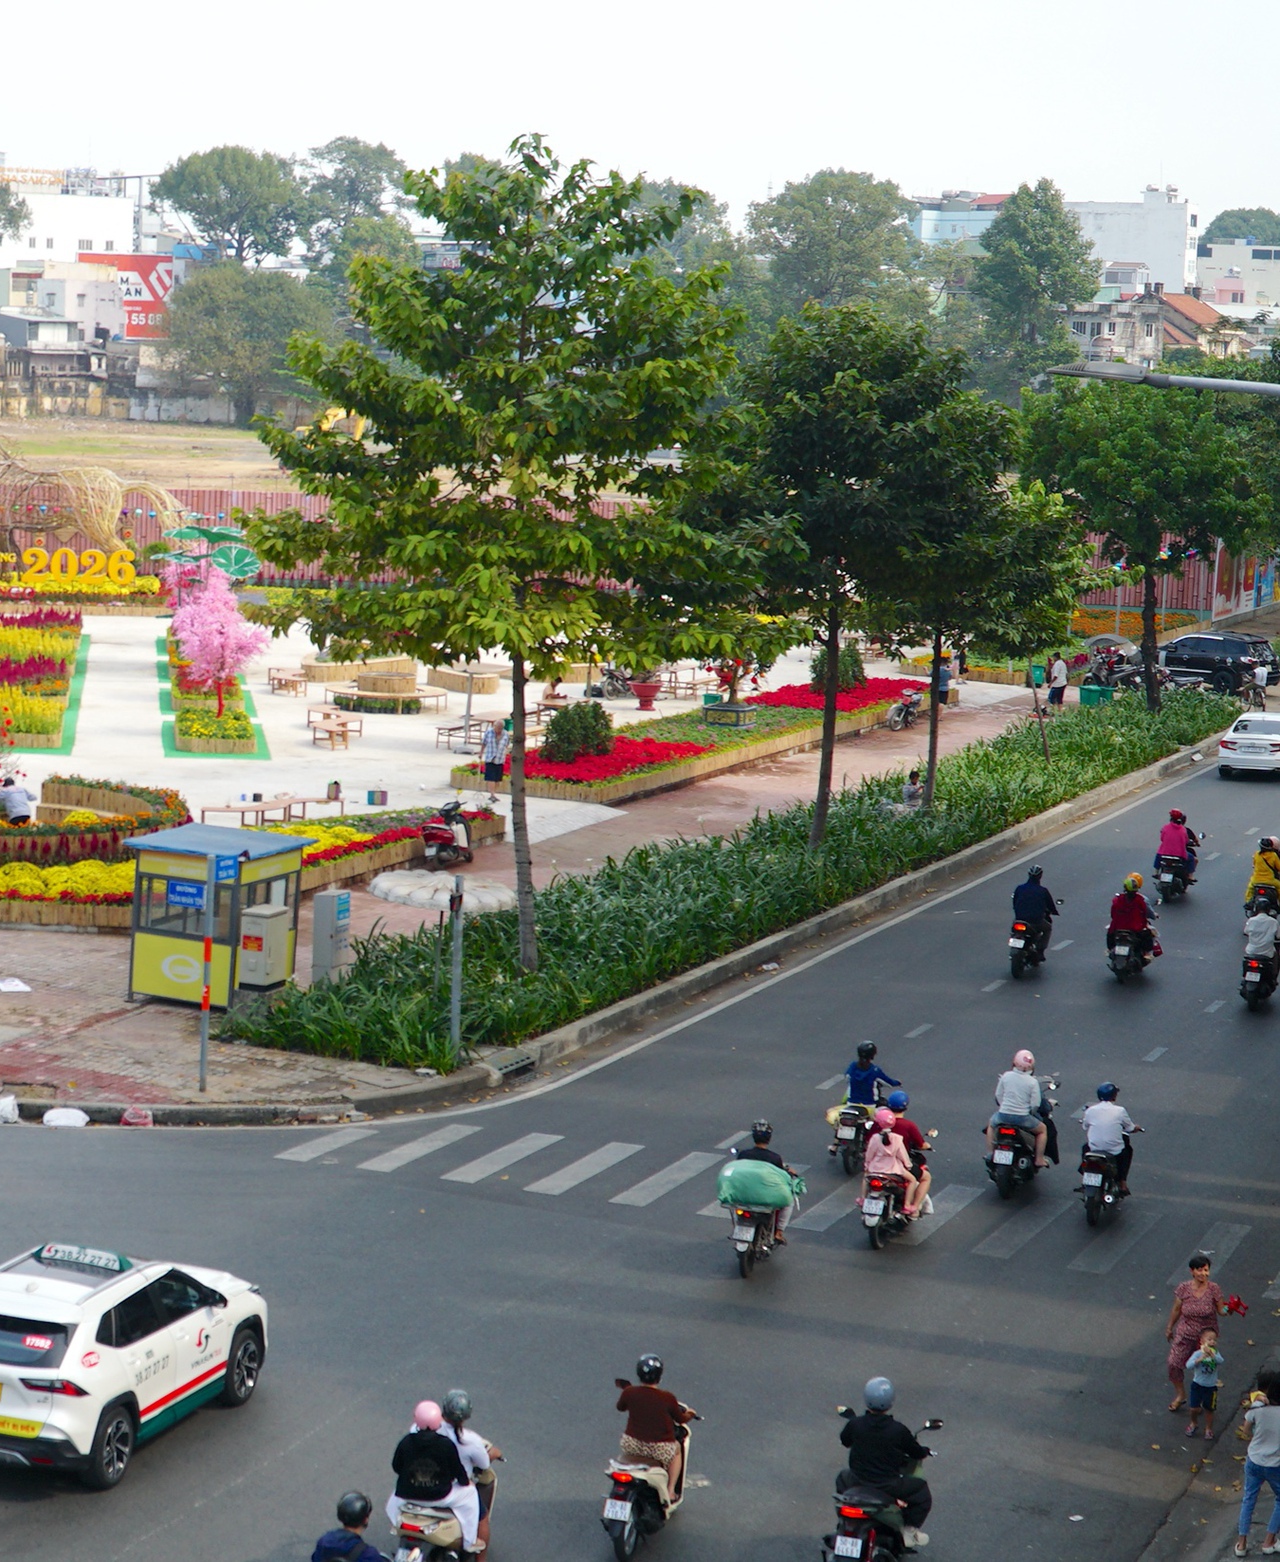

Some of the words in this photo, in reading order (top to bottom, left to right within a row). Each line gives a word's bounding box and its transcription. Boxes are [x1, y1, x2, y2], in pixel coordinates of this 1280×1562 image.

[20, 547, 136, 585] 2026
[89, 1254, 102, 1265] 27
[104, 1258, 118, 1268] 27
